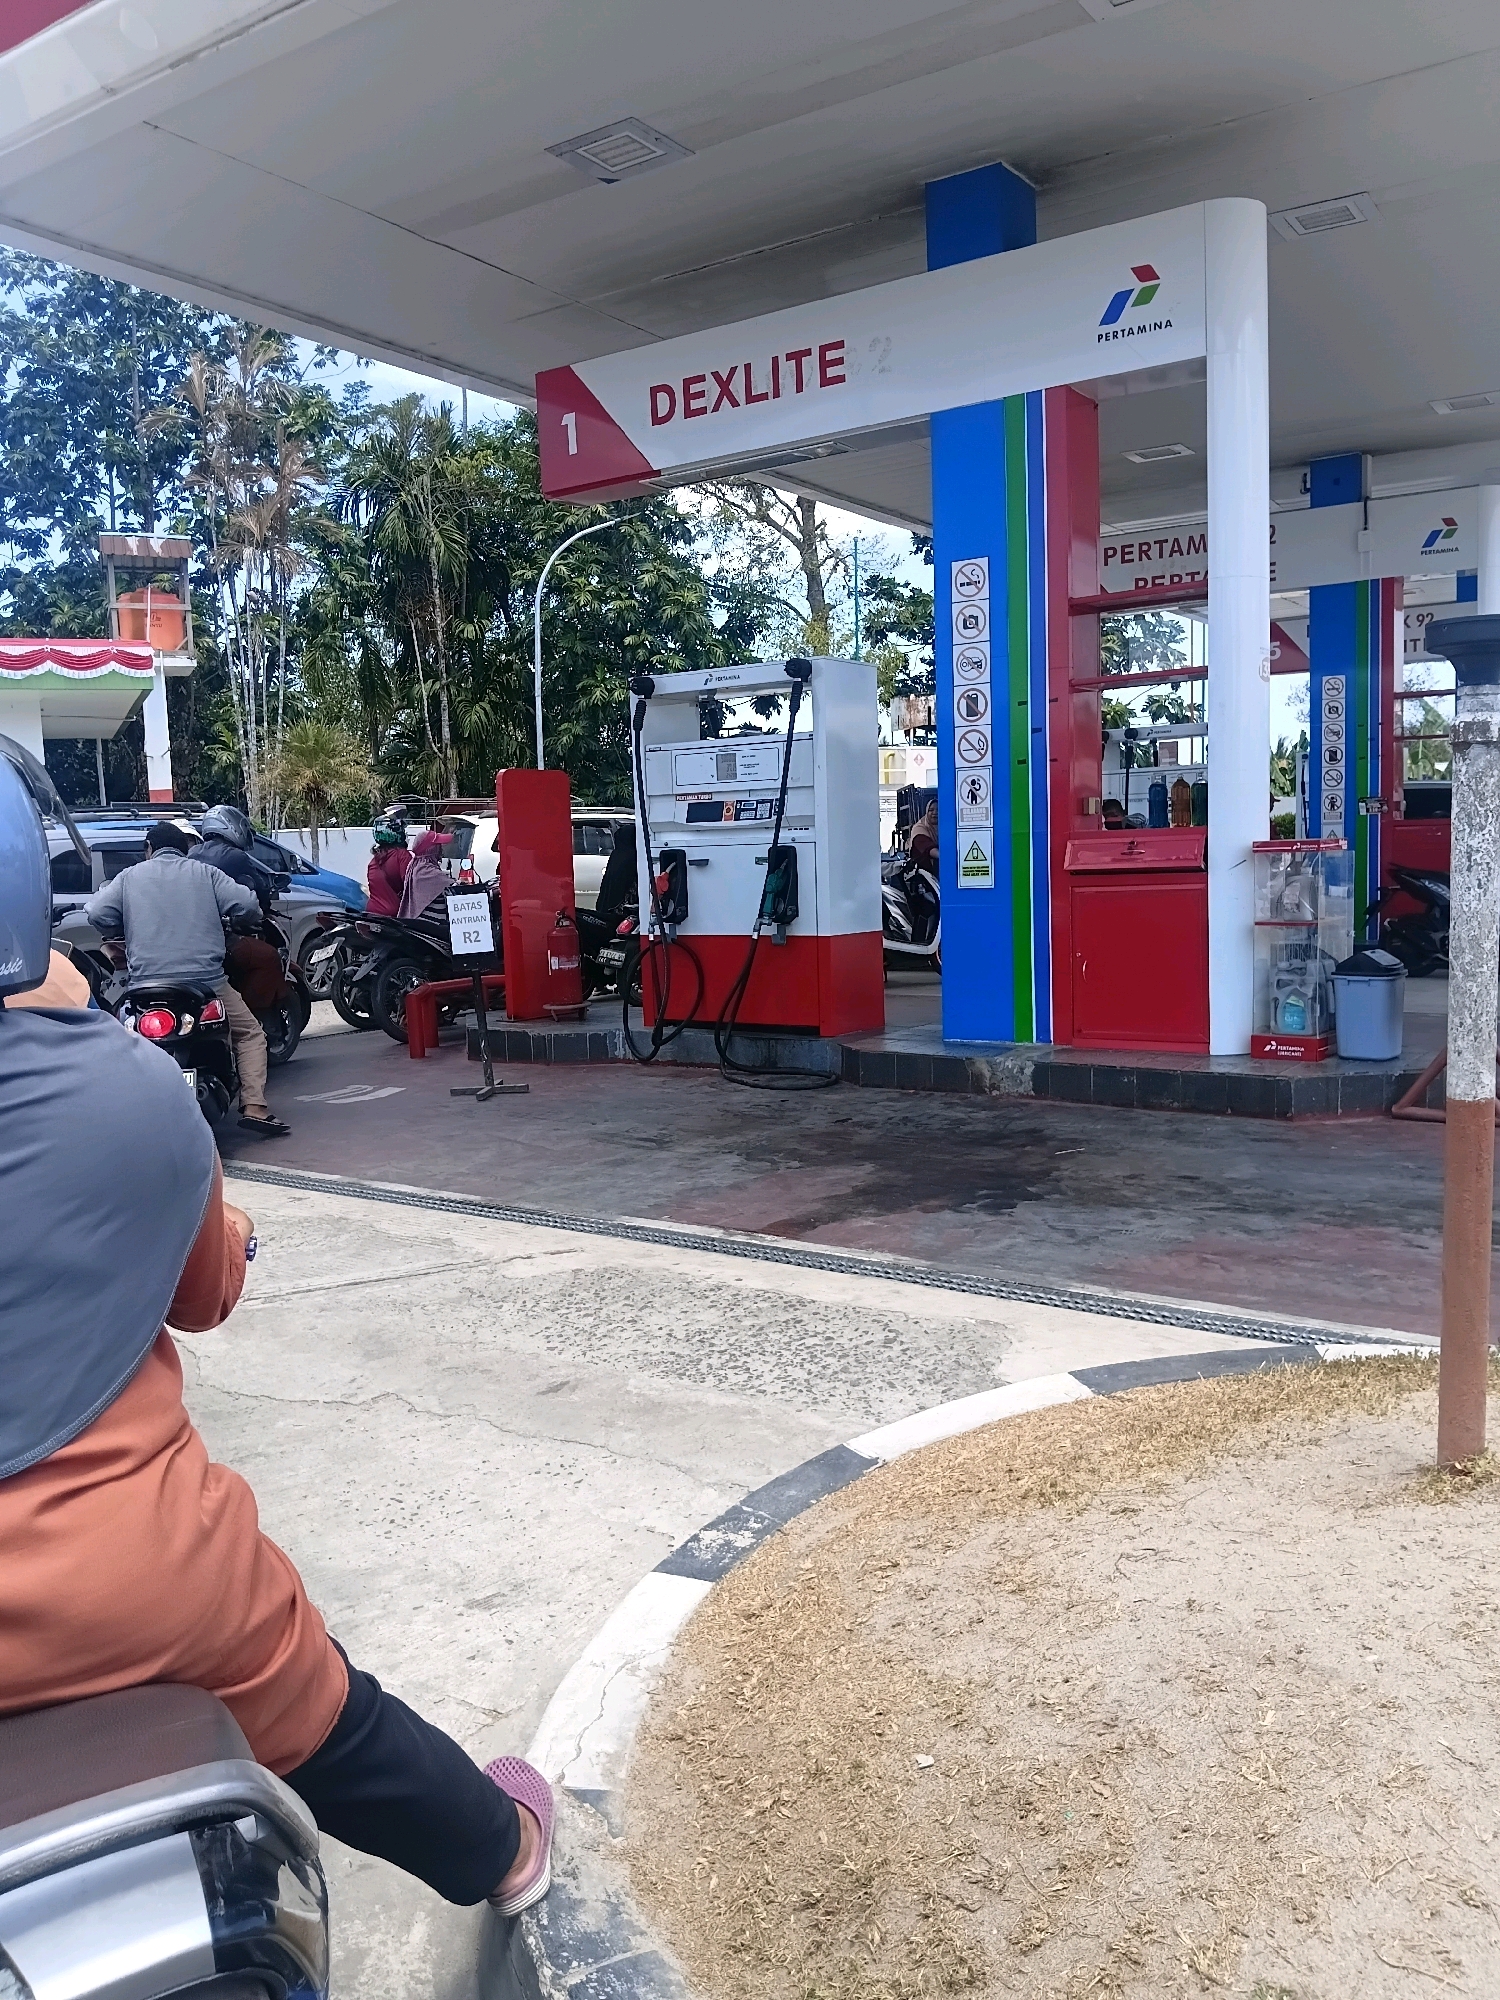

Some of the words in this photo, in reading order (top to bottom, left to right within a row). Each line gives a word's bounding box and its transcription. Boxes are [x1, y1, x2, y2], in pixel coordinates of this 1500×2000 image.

[1097, 319, 1173, 343] PERTAMINA
[649, 339, 847, 427] DEXLITE
[560, 411, 578, 456] 1
[1103, 533, 1208, 567] PERTAM
[1420, 546, 1460, 556] PERTAMINA
[1269, 641, 1282, 661] 5
[453, 901, 483, 912] BATAS
[451, 915, 487, 925] ANTRIAN
[462, 930, 481, 944] R2
